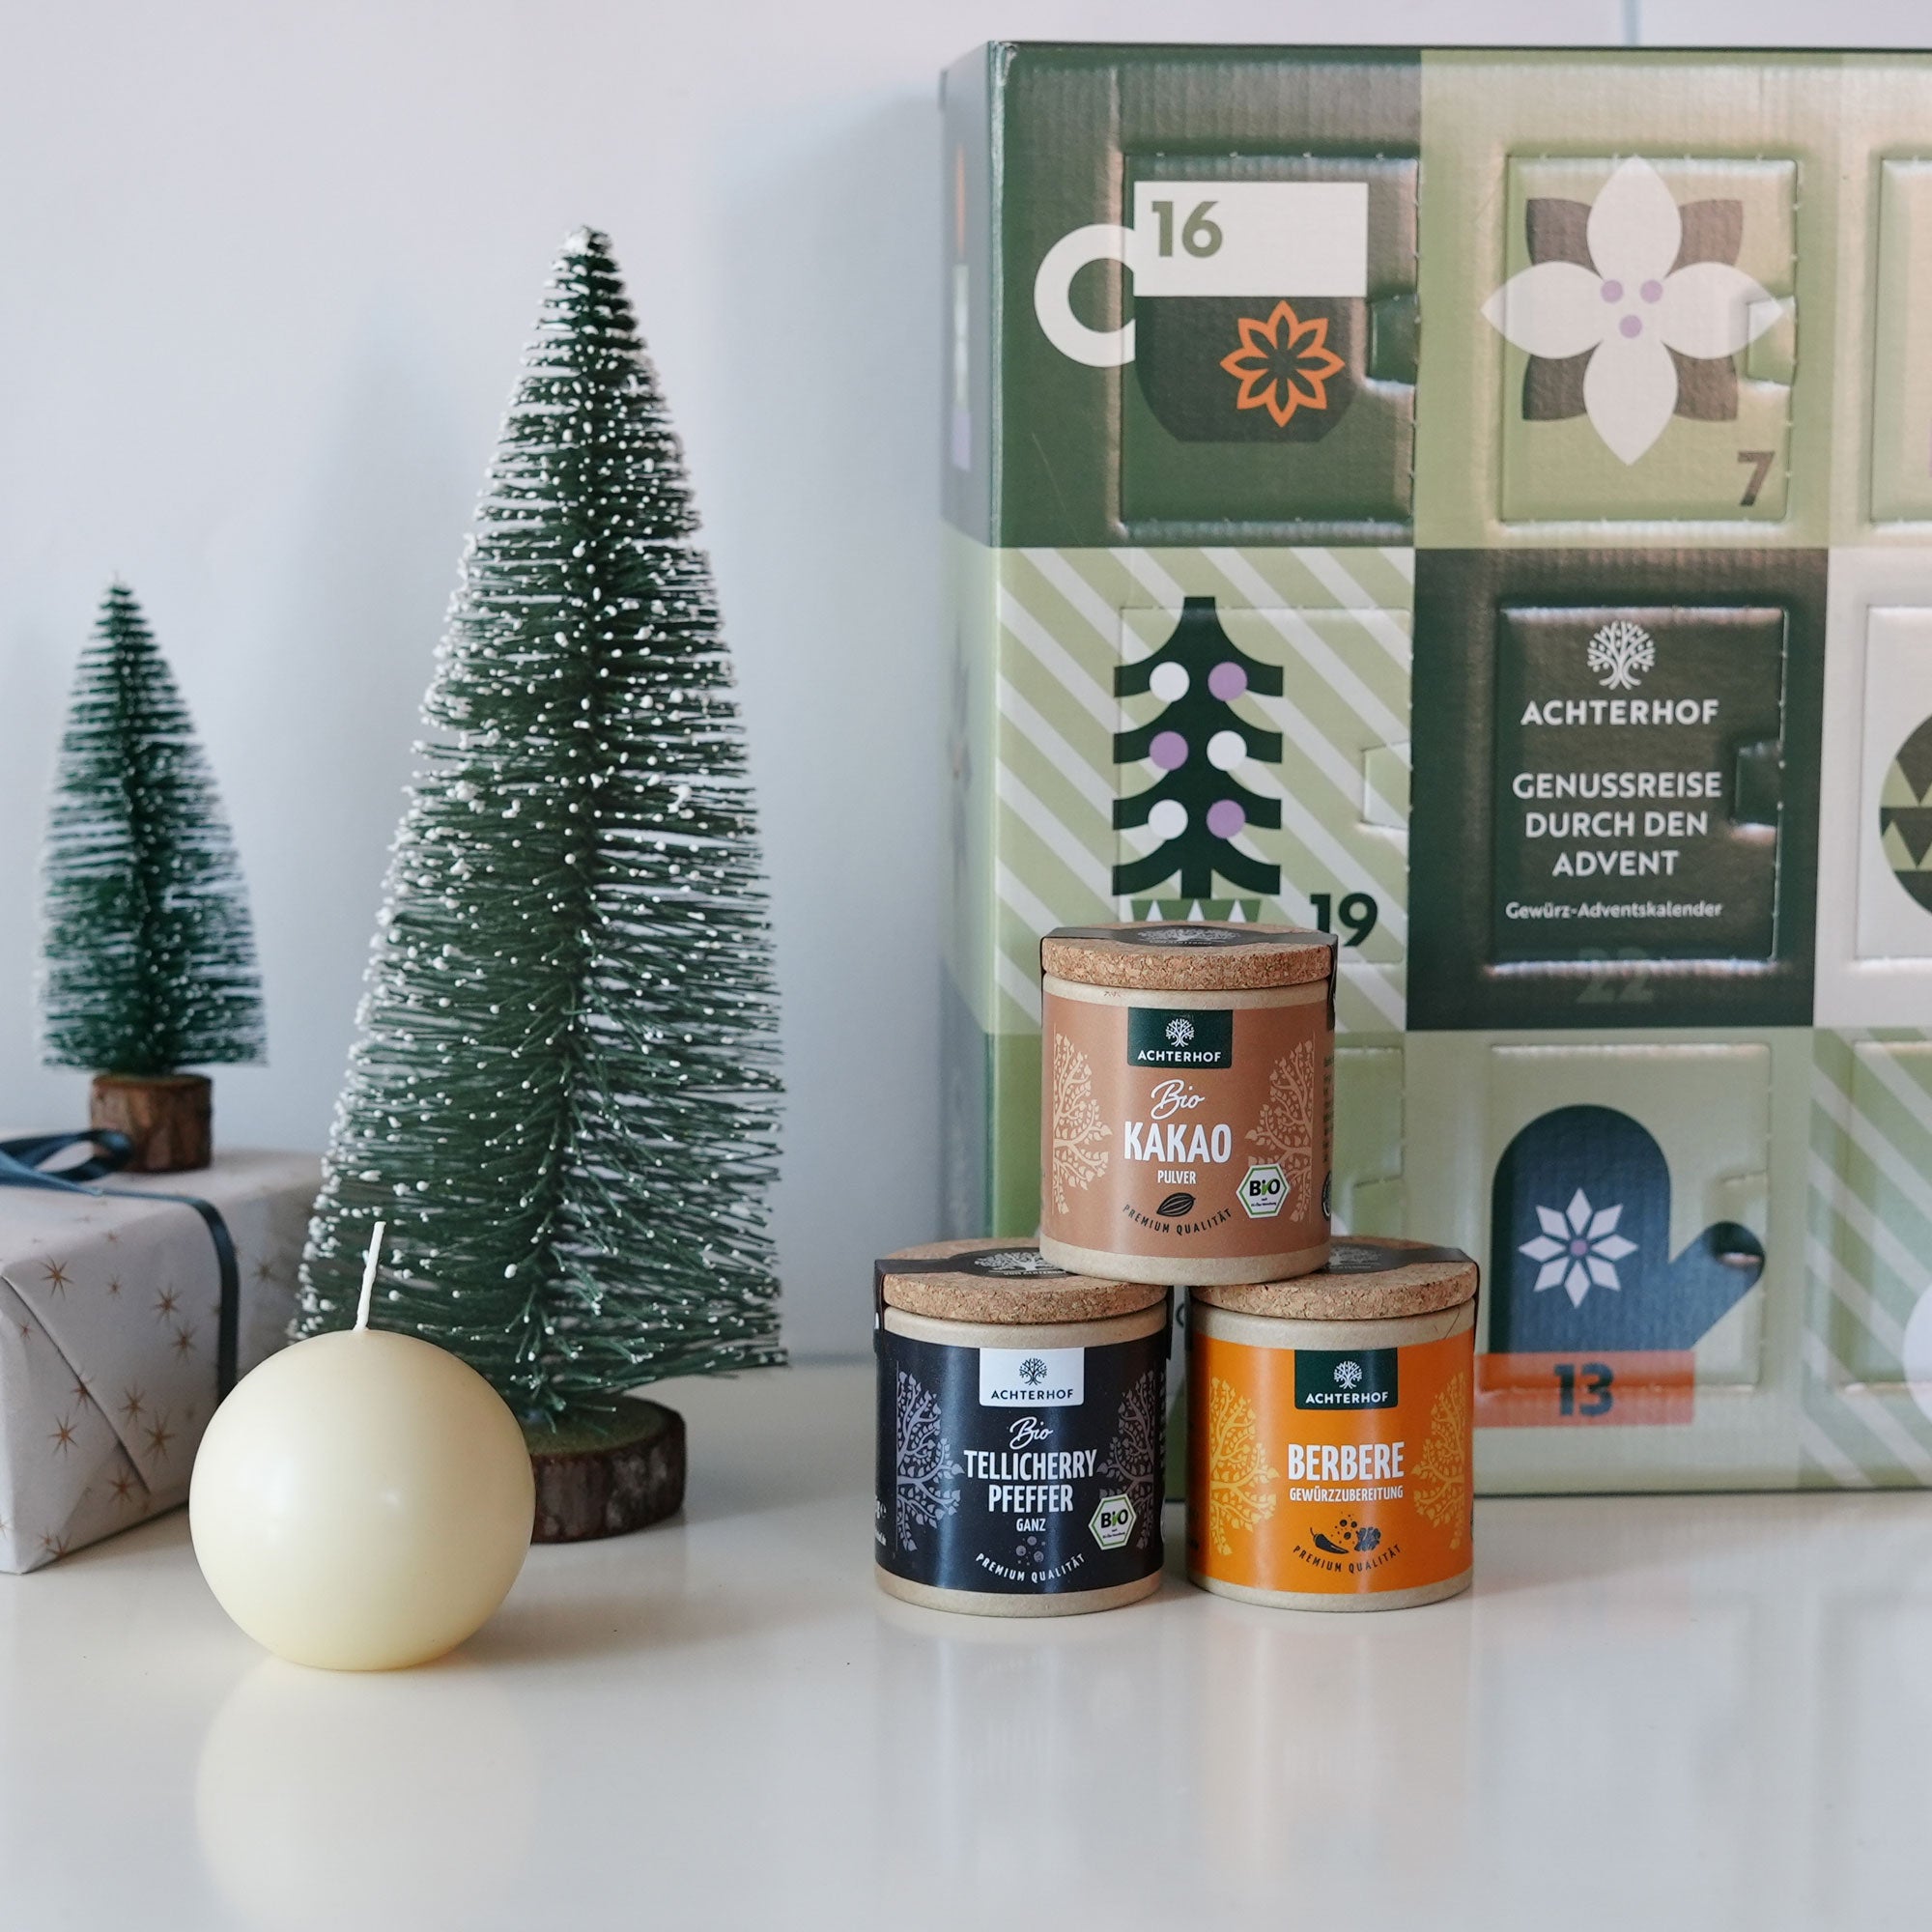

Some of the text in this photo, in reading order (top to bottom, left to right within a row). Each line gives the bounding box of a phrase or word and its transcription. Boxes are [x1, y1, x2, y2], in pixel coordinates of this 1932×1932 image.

[1151, 201, 1223, 259] 16
[1737, 451, 1776, 506] 7
[1520, 699, 1719, 725] ACHTERHOF
[1512, 772, 1722, 799] GENUSSREISE
[1524, 810, 1709, 838] DURCH DEN
[1551, 850, 1680, 877] ADVENT
[1310, 893, 1378, 947] 19
[1505, 899, 1724, 920] Gewürz-Adventskalender
[1137, 1049, 1222, 1064] ACHTERHOF
[1151, 1079, 1206, 1121] Bio
[1123, 1121, 1233, 1163] KAKAO
[1156, 1169, 1197, 1185] PULVER
[1122, 1204, 1233, 1236] PREMIUM QUALITÄT
[990, 1388, 1075, 1401] ACHTERHOF
[1305, 1391, 1389, 1405] ACHTERHOF
[1553, 1363, 1616, 1417] 13
[1009, 1416, 1054, 1449] Bio
[963, 1449, 1097, 1482] TELLICHERRY
[1288, 1441, 1405, 1481] BERBERE
[988, 1484, 1074, 1514] PFEFFER
[1289, 1485, 1405, 1503] GEWÜRZZUBEREITUNG
[1016, 1518, 1046, 1533] GANZ
[976, 1552, 1085, 1583] PREMIUM QUALITÄT
[1293, 1544, 1402, 1574] PREMIUM QUALITÄT
